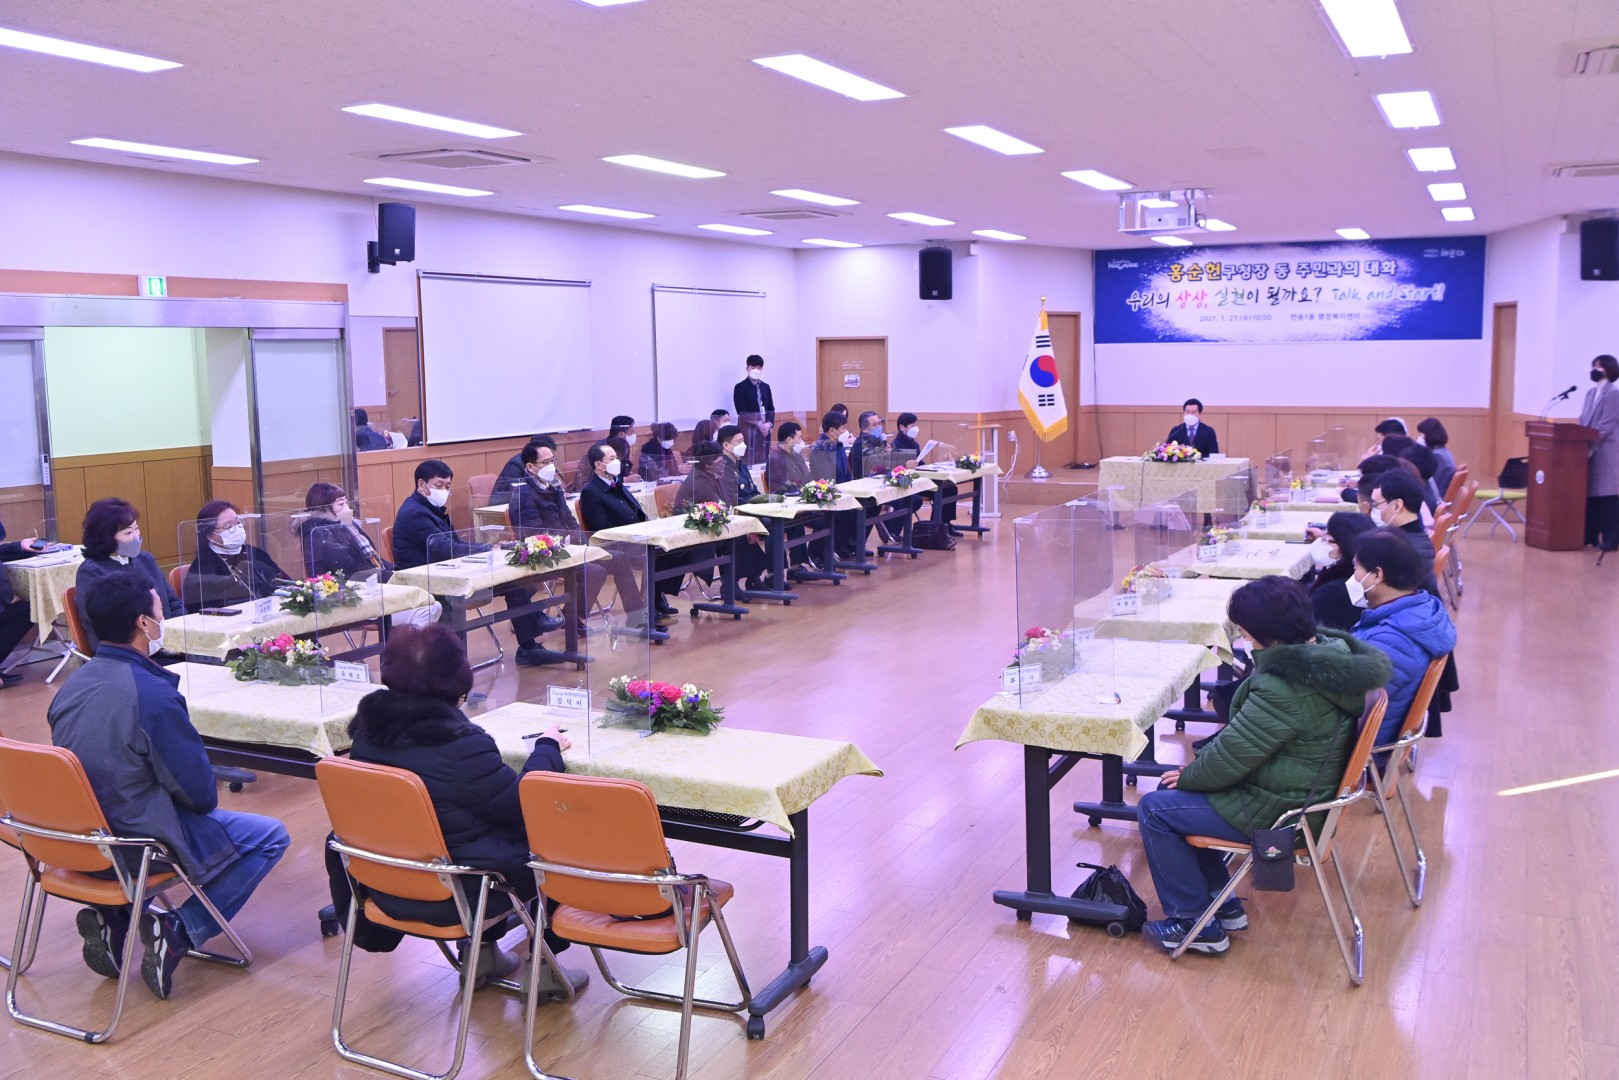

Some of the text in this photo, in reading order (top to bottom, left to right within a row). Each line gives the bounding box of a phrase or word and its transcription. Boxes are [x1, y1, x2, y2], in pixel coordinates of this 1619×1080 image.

[1168, 259, 1398, 282] 홍순헌구청장 동 주민과의 대화
[1126, 290, 1170, 312] 우리의
[1175, 289, 1208, 309] 상상,
[1214, 287, 1259, 307] 실현이
[1267, 286, 1322, 306] 될까요?
[1331, 287, 1361, 301] Talk
[1366, 285, 1395, 301] and
